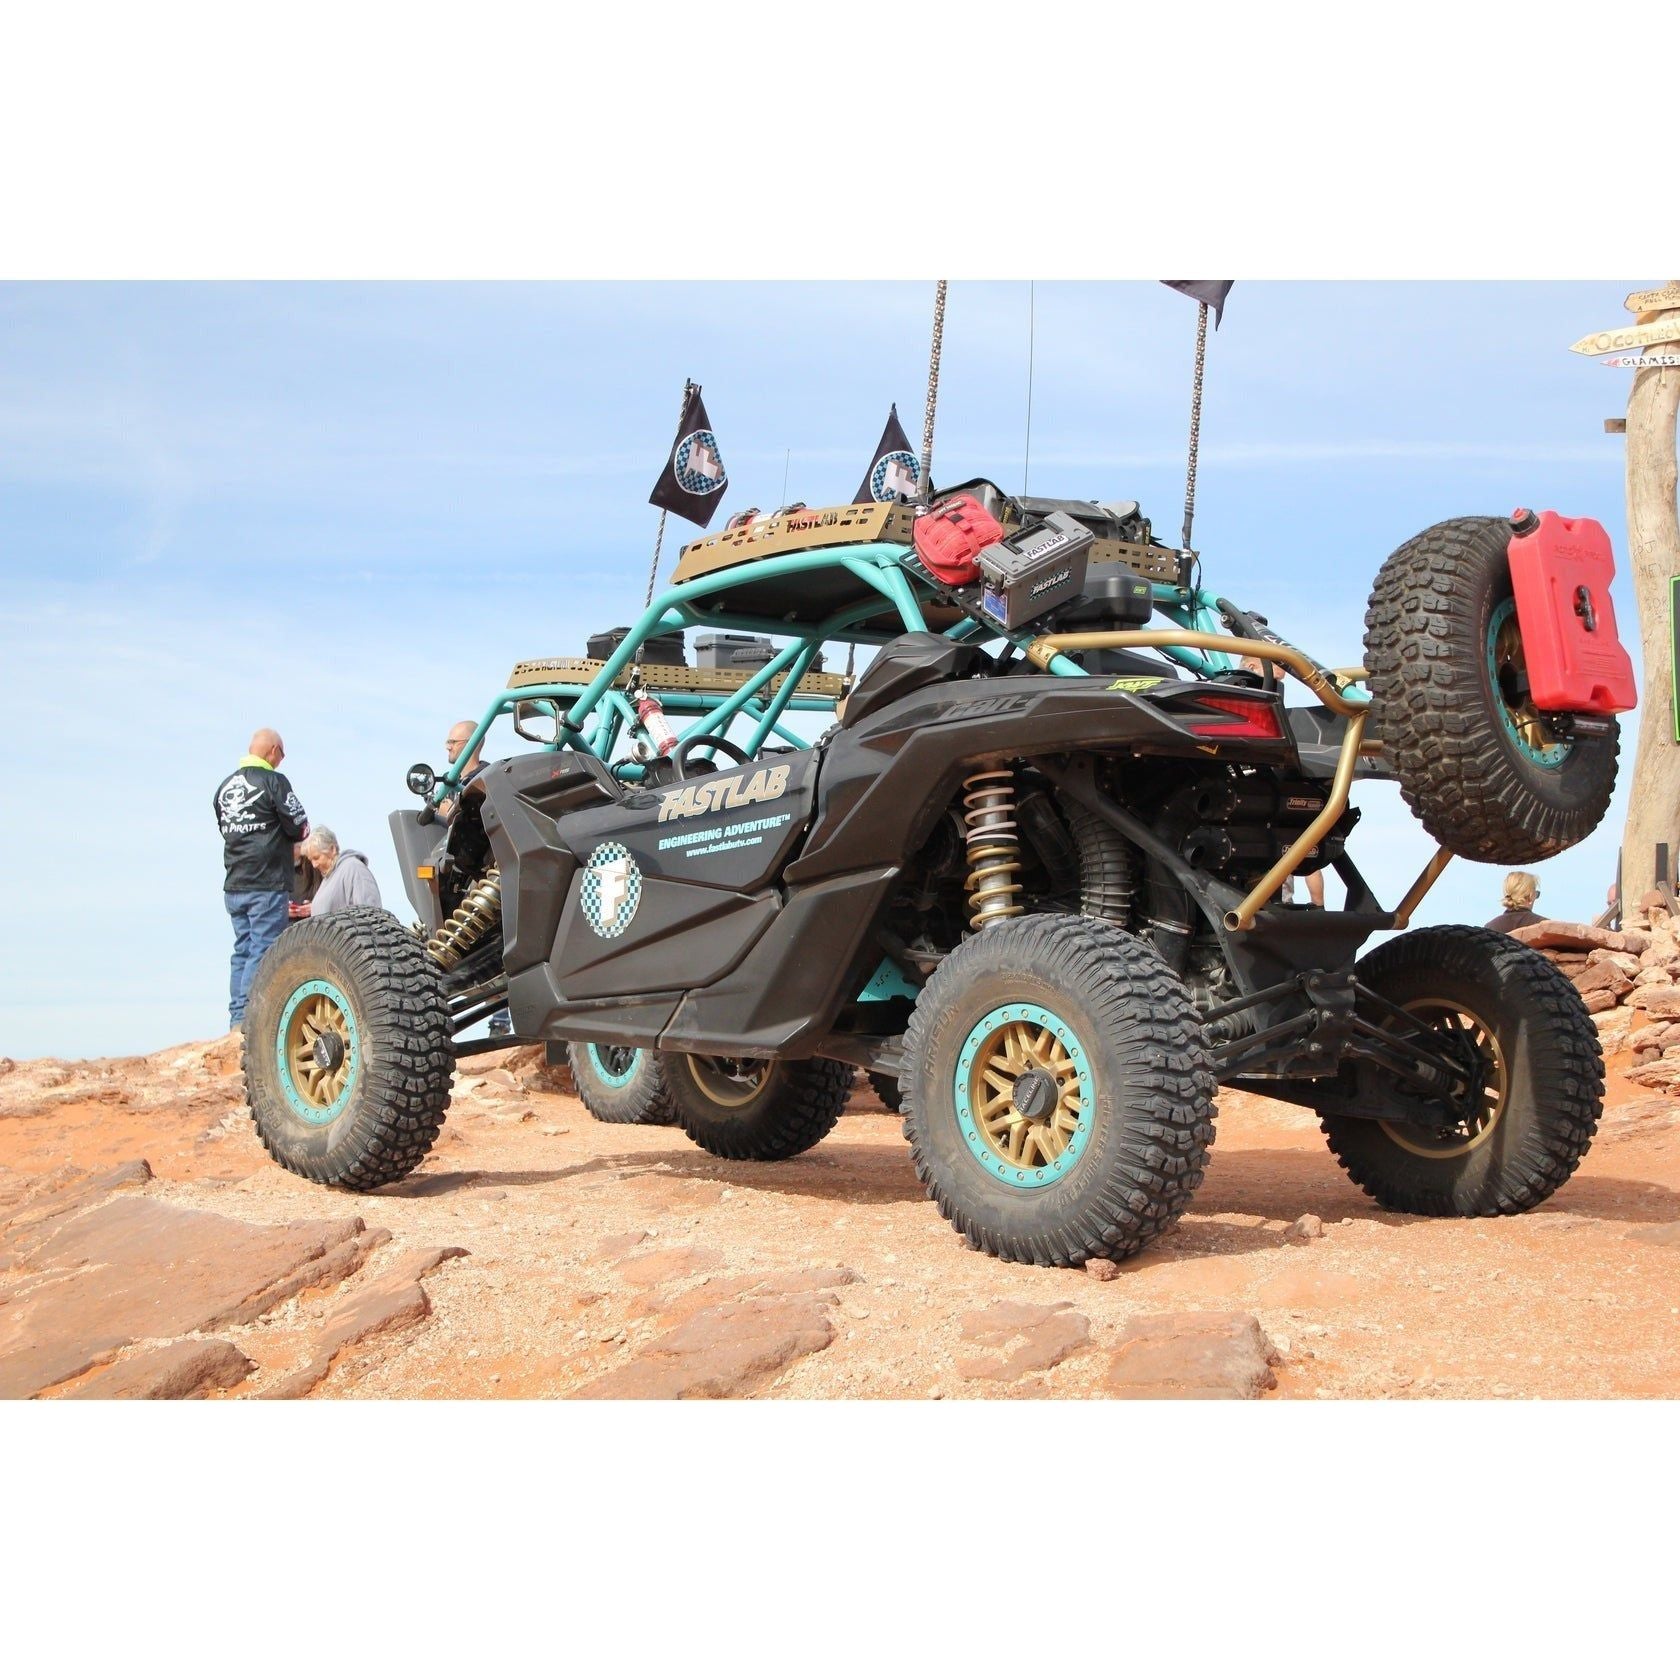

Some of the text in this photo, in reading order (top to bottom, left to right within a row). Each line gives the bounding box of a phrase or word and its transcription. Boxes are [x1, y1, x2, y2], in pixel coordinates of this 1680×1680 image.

[786, 512, 838, 533] FASTLAB
[1026, 534, 1065, 557] FASTLAB
[1032, 570, 1070, 595] FASTLAB
[658, 765, 790, 822] FASTLAB
[229, 823, 266, 833] PIRATES
[658, 828, 722, 850] ENGINEERING
[686, 836, 762, 857] www.fastlabutv.com
